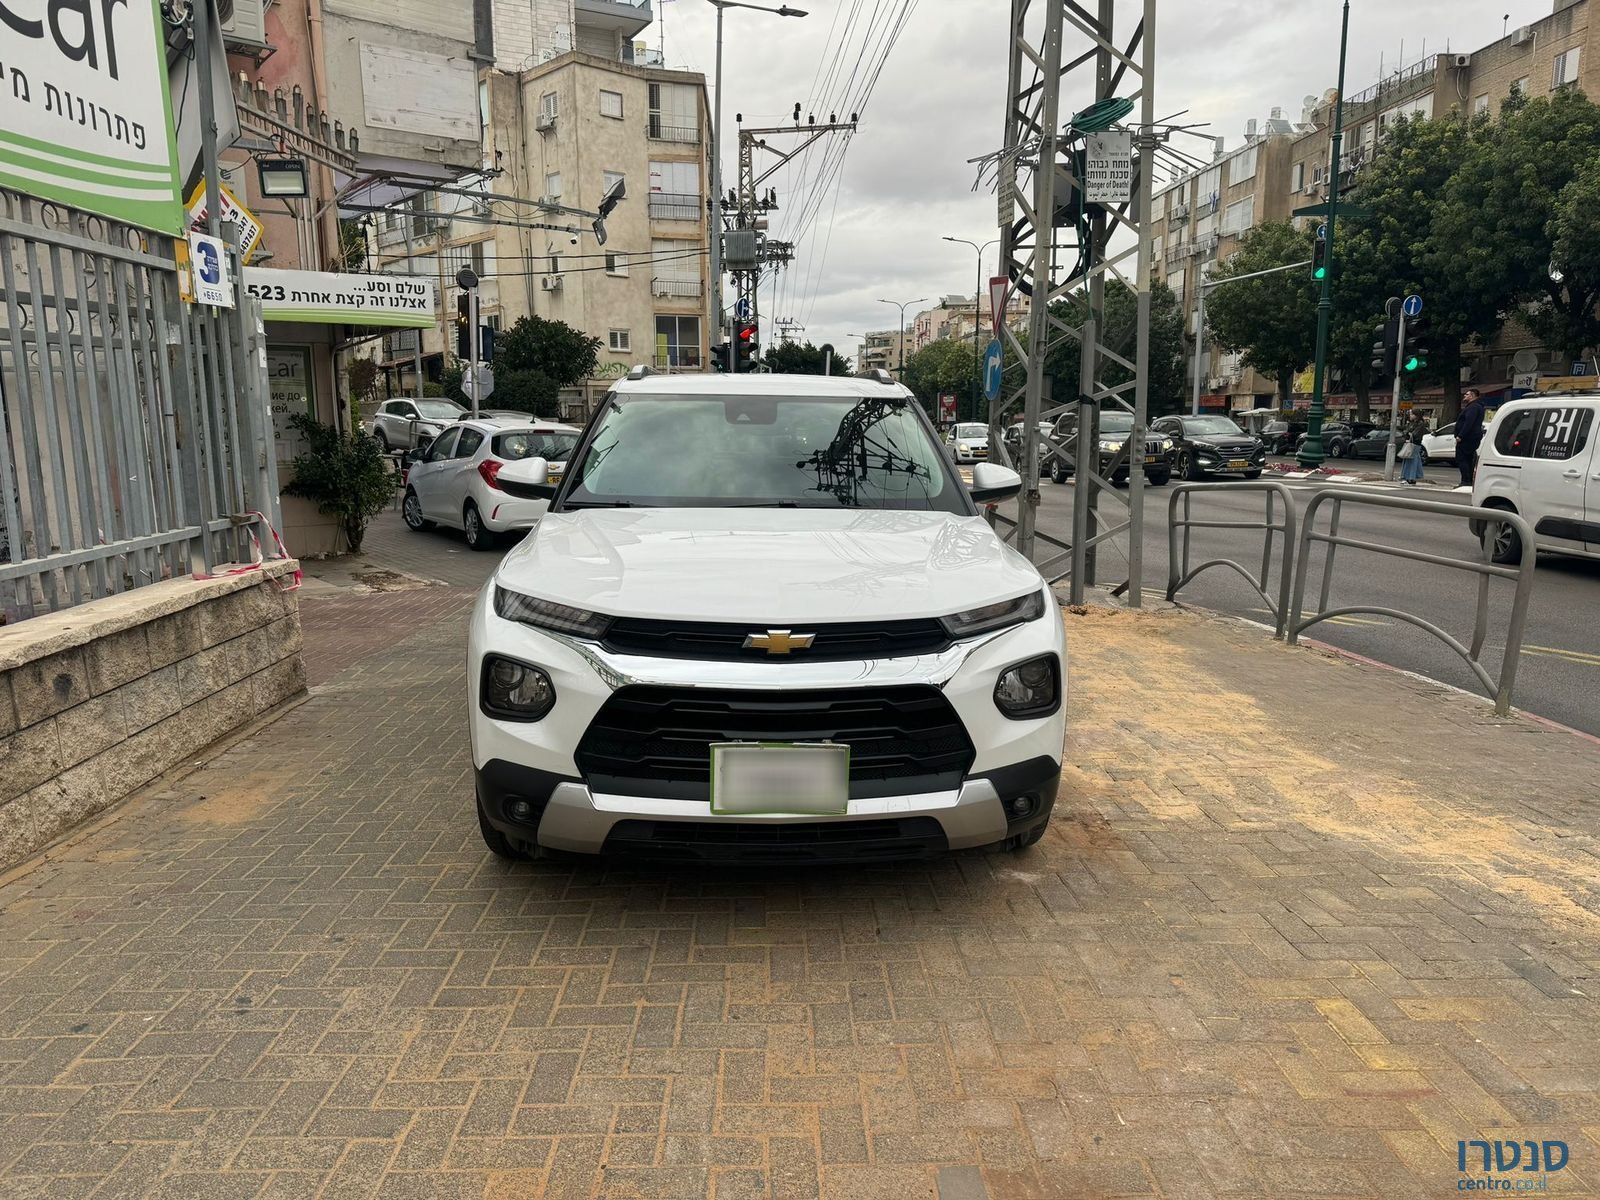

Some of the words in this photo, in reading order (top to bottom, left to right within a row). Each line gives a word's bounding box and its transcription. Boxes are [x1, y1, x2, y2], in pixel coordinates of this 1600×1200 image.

[43, 81, 146, 150] פתרונות
[1112, 160, 1128, 168] מתח
[1110, 170, 1128, 179] סכנת
[1088, 180, 1105, 190] Danger
[1106, 180, 1112, 188] of
[396, 282, 426, 294] שלם
[291, 290, 331, 304] אחרת
[336, 294, 364, 308] קצת
[370, 296, 385, 306] זה
[390, 295, 426, 309] אצלנו
[1543, 408, 1578, 444] BH
